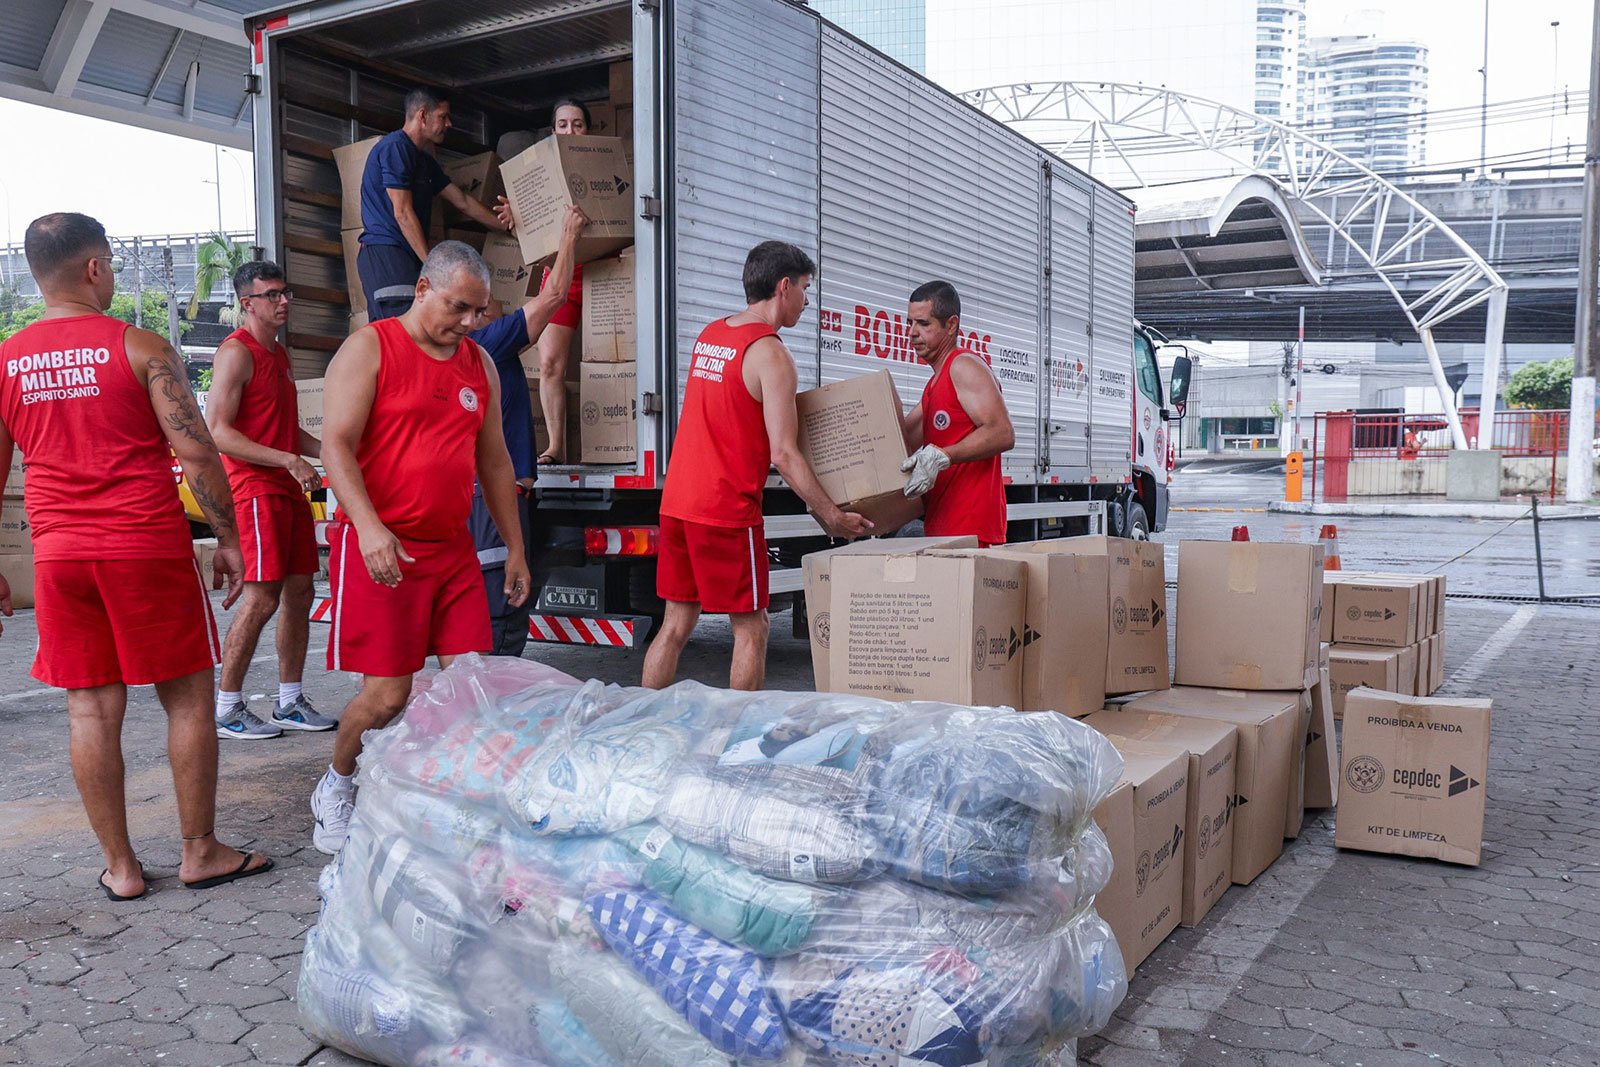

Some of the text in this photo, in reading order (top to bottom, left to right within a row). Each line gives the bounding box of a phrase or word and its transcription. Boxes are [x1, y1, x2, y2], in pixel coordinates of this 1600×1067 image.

[707, 372, 723, 383] SANTO
[67, 386, 100, 398] SANTO
[603, 403, 628, 420] cepdec
[547, 592, 596, 605] CALVI
[1139, 666, 1157, 674] LIMPEZA
[1367, 716, 1415, 729] PROIBIDA
[1427, 723, 1463, 734] VENDA
[1393, 768, 1441, 789] cepdec
[1367, 825, 1447, 843] KIT DE LIMPEZA
